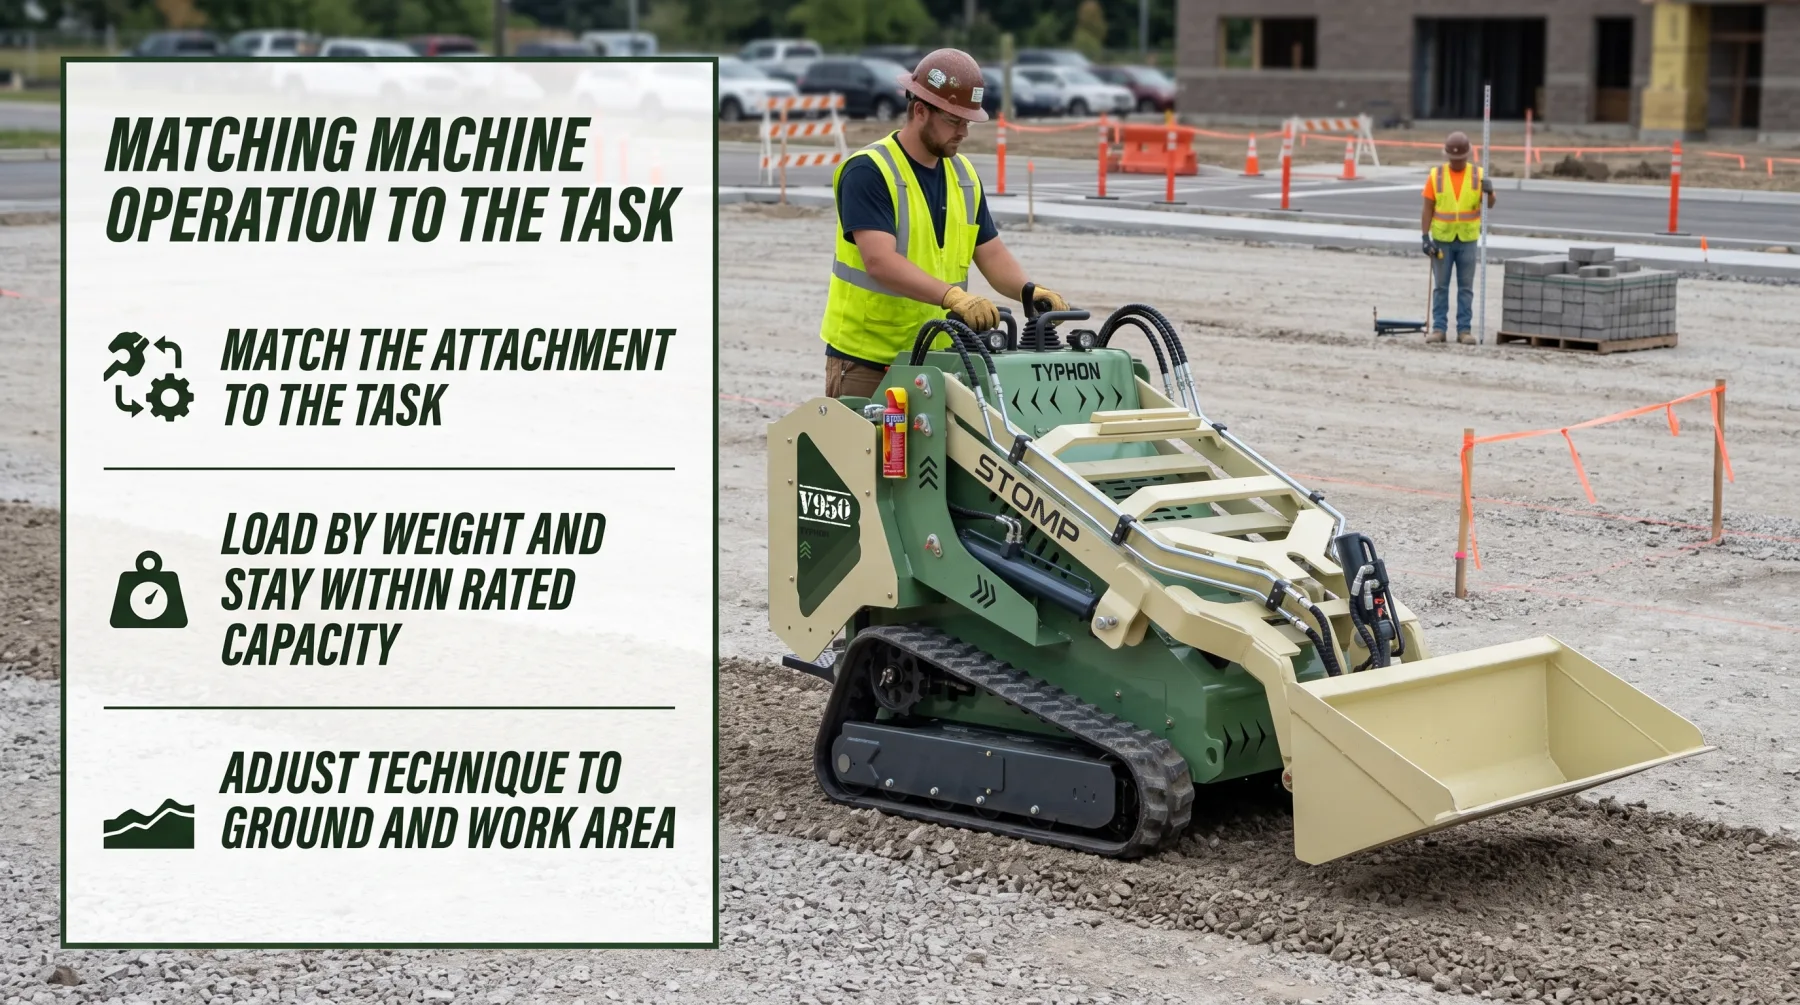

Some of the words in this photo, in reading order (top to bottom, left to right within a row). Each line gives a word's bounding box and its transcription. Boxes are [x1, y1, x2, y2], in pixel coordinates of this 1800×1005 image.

[1031, 362, 1101, 381] TYPHON
[799, 490, 851, 520] V950
[975, 454, 1079, 542] STOMP
